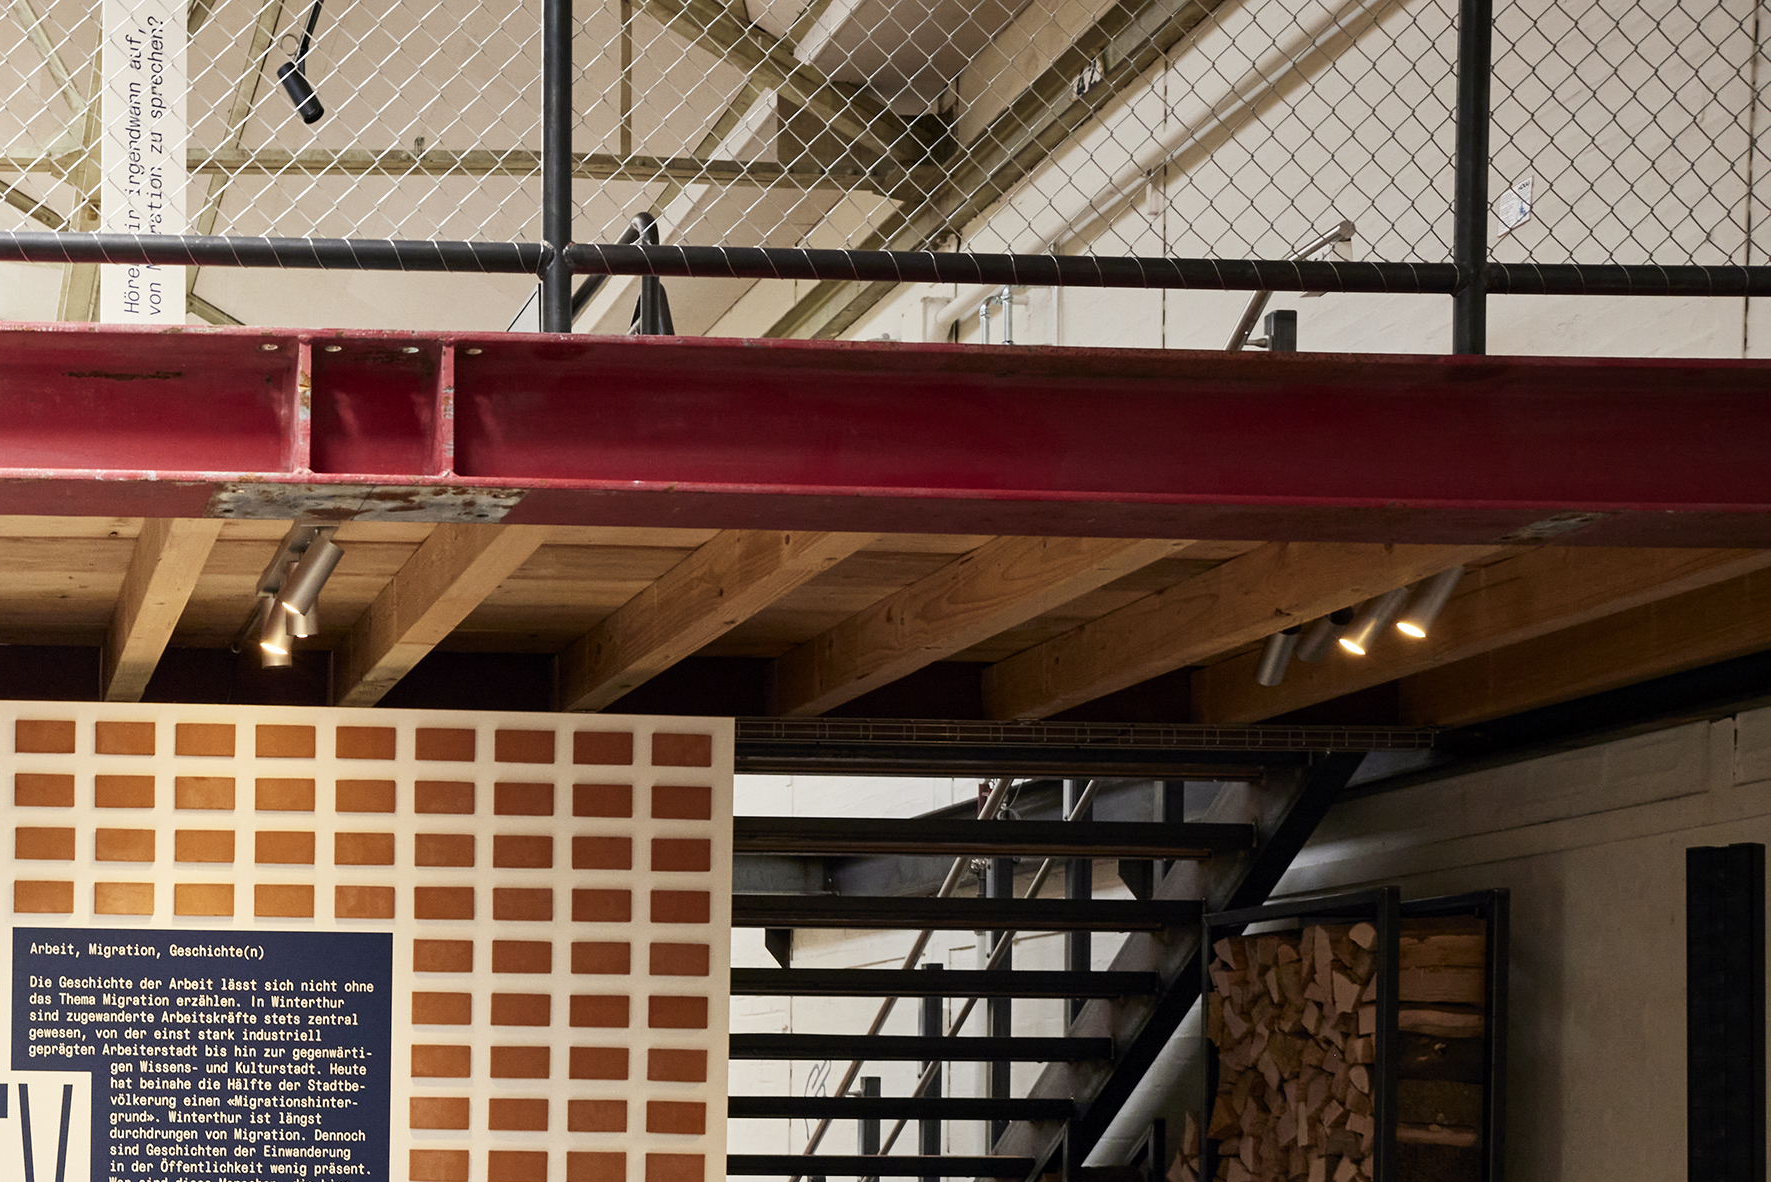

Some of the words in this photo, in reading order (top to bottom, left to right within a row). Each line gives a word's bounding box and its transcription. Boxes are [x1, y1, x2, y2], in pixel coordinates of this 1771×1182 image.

[124, 26, 147, 71] auf,
[146, 15, 165, 120] sprechen?
[124, 81, 145, 197] irgendwann
[149, 132, 164, 155] zu
[124, 263, 142, 315] Höre
[148, 282, 163, 316] von
[30, 942, 80, 958] Arbeit,
[89, 943, 161, 959] Migration,
[169, 944, 264, 960] Geschichte(n)
[30, 975, 52, 988] Die
[59, 976, 133, 989] Geschichte
[139, 977, 162, 990] der
[169, 977, 213, 990] Arbeit
[221, 978, 257, 991] lässt
[264, 979, 294, 991] sich
[301, 979, 337, 992] nicht
[344, 980, 374, 993] ohne
[29, 992, 52, 1005] das
[59, 992, 96, 1005] Thema
[103, 993, 169, 1008] Migration
[176, 994, 241, 1007] erzählen.
[251, 995, 264, 1007] In
[271, 995, 345, 1009] Winterthur
[29, 1009, 59, 1021] sind
[66, 1010, 155, 1025] zugewanderte
[161, 1011, 257, 1024] Arbeitskräfte
[264, 1013, 300, 1025] stets
[308, 1013, 358, 1026] zentral
[29, 1028, 86, 1041] gewesen,
[95, 1029, 118, 1039] von
[124, 1027, 147, 1039] der
[154, 1027, 191, 1040] einst
[198, 1028, 235, 1040] stark
[242, 1028, 322, 1042] industriell
[29, 1043, 95, 1058] geprägten
[102, 1043, 198, 1057] Arbeiterstadt
[205, 1044, 227, 1057] bis
[234, 1045, 256, 1057] hin
[263, 1048, 286, 1058] zur
[292, 1046, 372, 1061] gegenwärti-
[110, 1062, 133, 1075] gen
[139, 1060, 198, 1073] Wissens-
[206, 1061, 228, 1074] und
[235, 1061, 321, 1075] Kulturstadt.
[330, 1063, 367, 1075] Heute
[110, 1076, 132, 1089] hat
[140, 1077, 191, 1090] beinahe
[198, 1078, 221, 1090] die
[227, 1078, 272, 1091] Hälfte
[278, 1079, 301, 1091] der
[307, 1079, 365, 1092] Stadtbe-
[110, 1093, 176, 1109] völkerung
[183, 1094, 220, 1107] einen
[227, 1095, 358, 1110] «Migrationshinter-
[110, 1110, 160, 1125] grund».
[168, 1110, 242, 1124] Winterthur
[250, 1111, 271, 1124] ist
[279, 1112, 322, 1127] längst
[109, 1126, 198, 1142] durchdrungen
[205, 1130, 227, 1140] von
[234, 1128, 305, 1143] Migration.
[314, 1129, 366, 1142] Dennoch
[110, 1143, 139, 1156] sind
[146, 1143, 227, 1157] Geschichten
[234, 1144, 256, 1157] der
[264, 1145, 351, 1161] Einwanderung
[110, 1160, 124, 1172] in
[131, 1160, 154, 1172] der
[160, 1158, 263, 1174] Öffentlichkeit
[270, 1162, 307, 1177] wenig
[314, 1162, 371, 1177] präsent.
